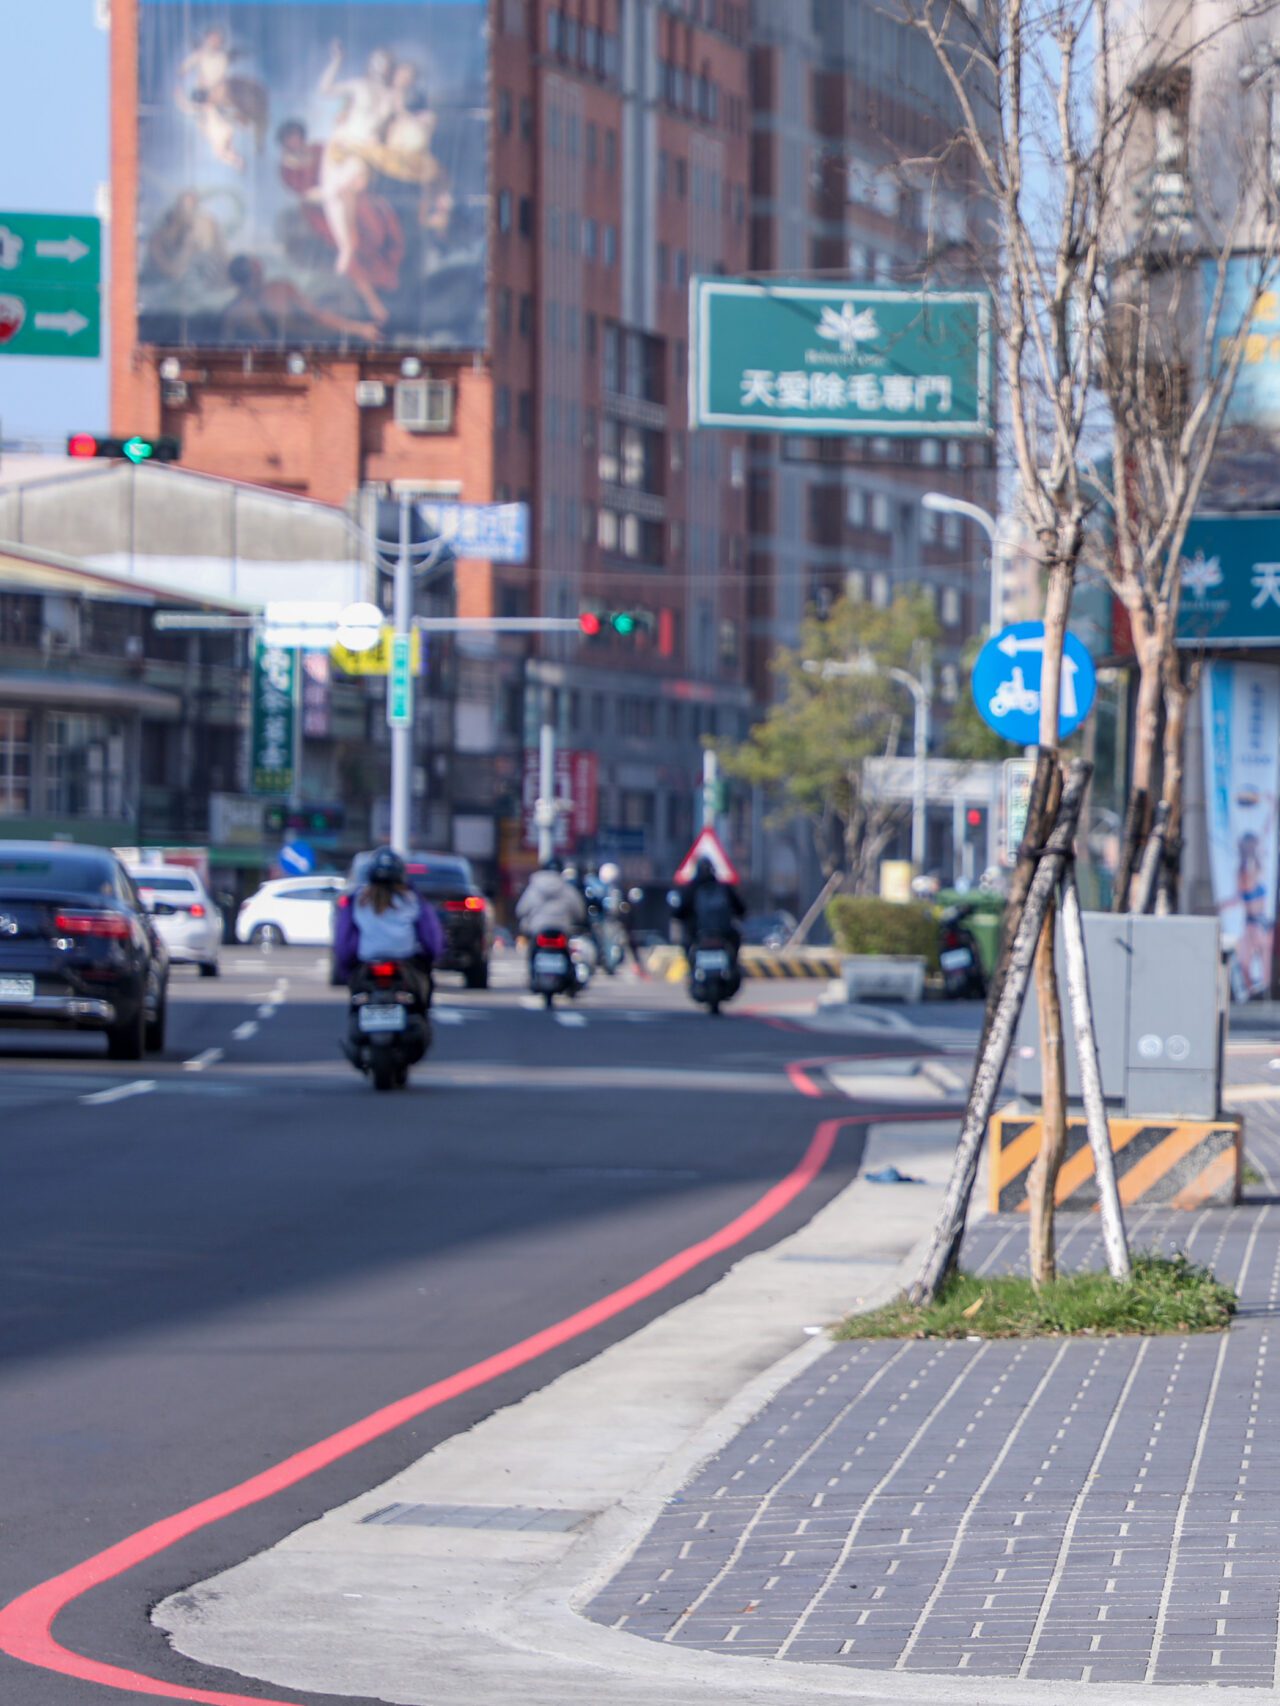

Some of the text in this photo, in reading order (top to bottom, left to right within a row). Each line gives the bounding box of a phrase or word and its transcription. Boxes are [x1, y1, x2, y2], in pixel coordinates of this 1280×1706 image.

[739, 368, 953, 413] 天愛除毛專門
